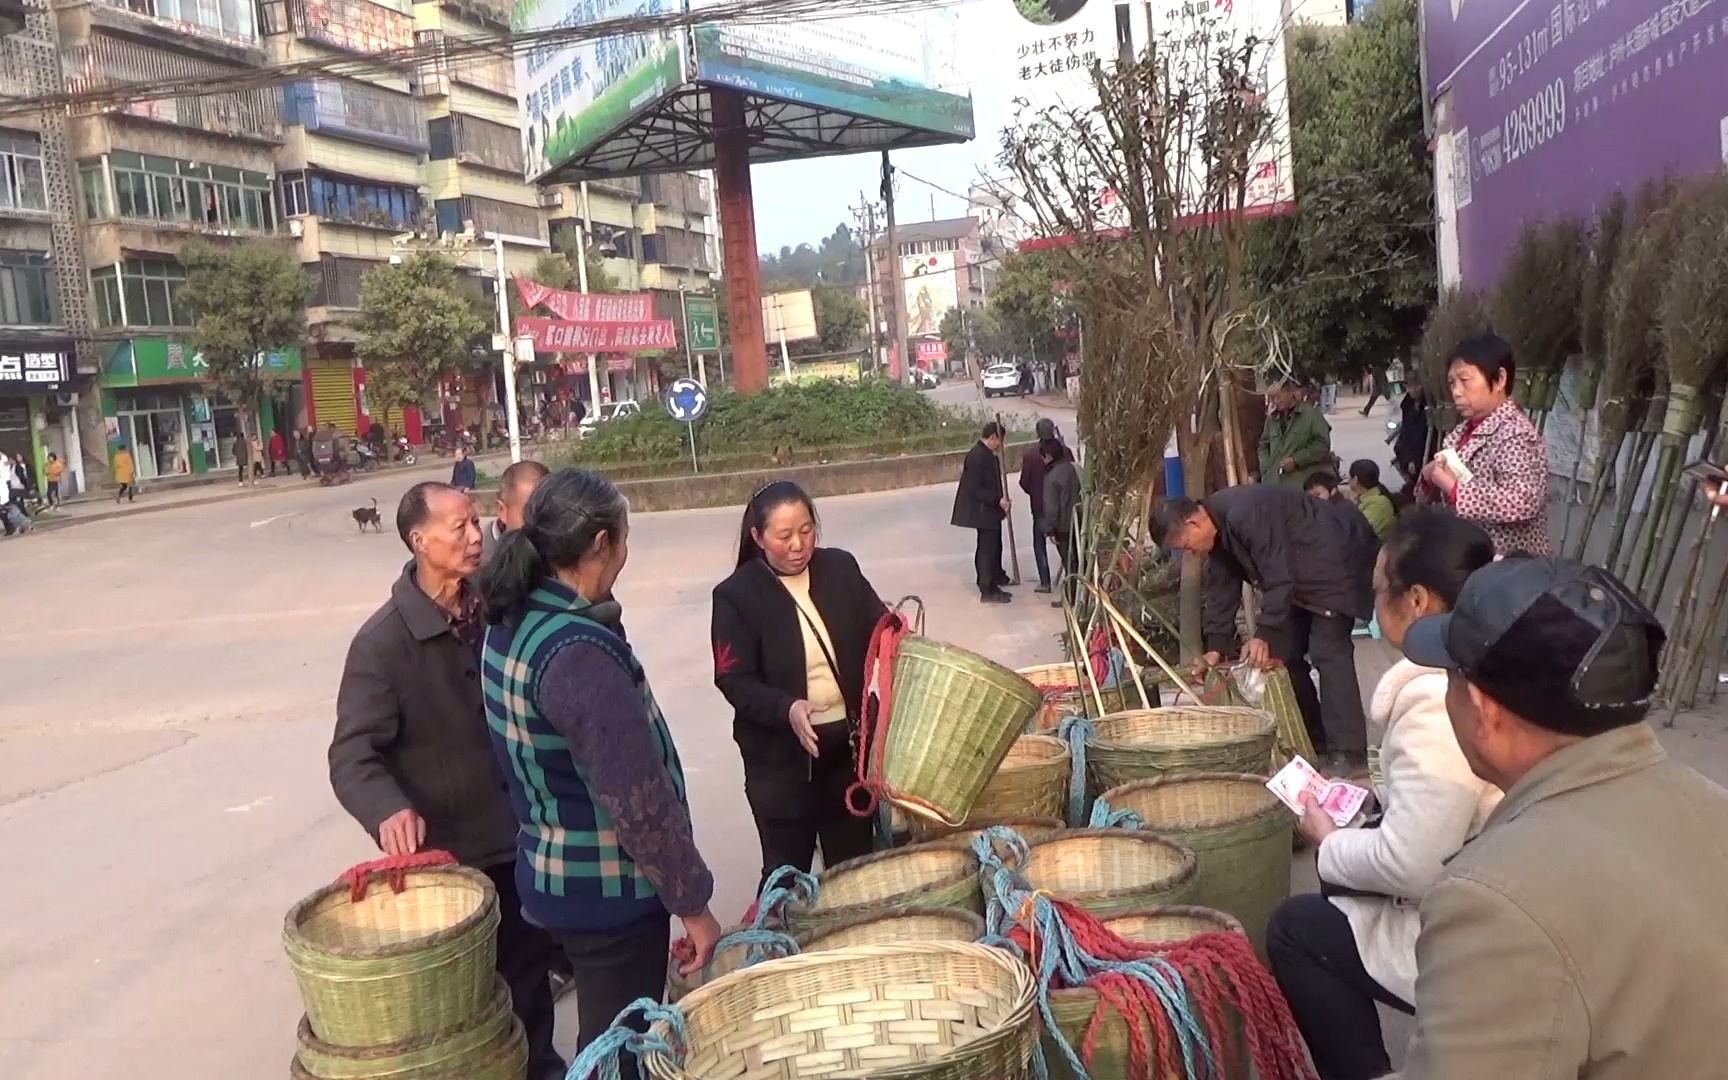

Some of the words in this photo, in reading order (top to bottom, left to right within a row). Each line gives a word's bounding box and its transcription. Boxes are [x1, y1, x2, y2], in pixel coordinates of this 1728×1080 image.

[1017, 27, 1095, 60] 少壮不努力
[1502, 77, 1566, 163] 4269999
